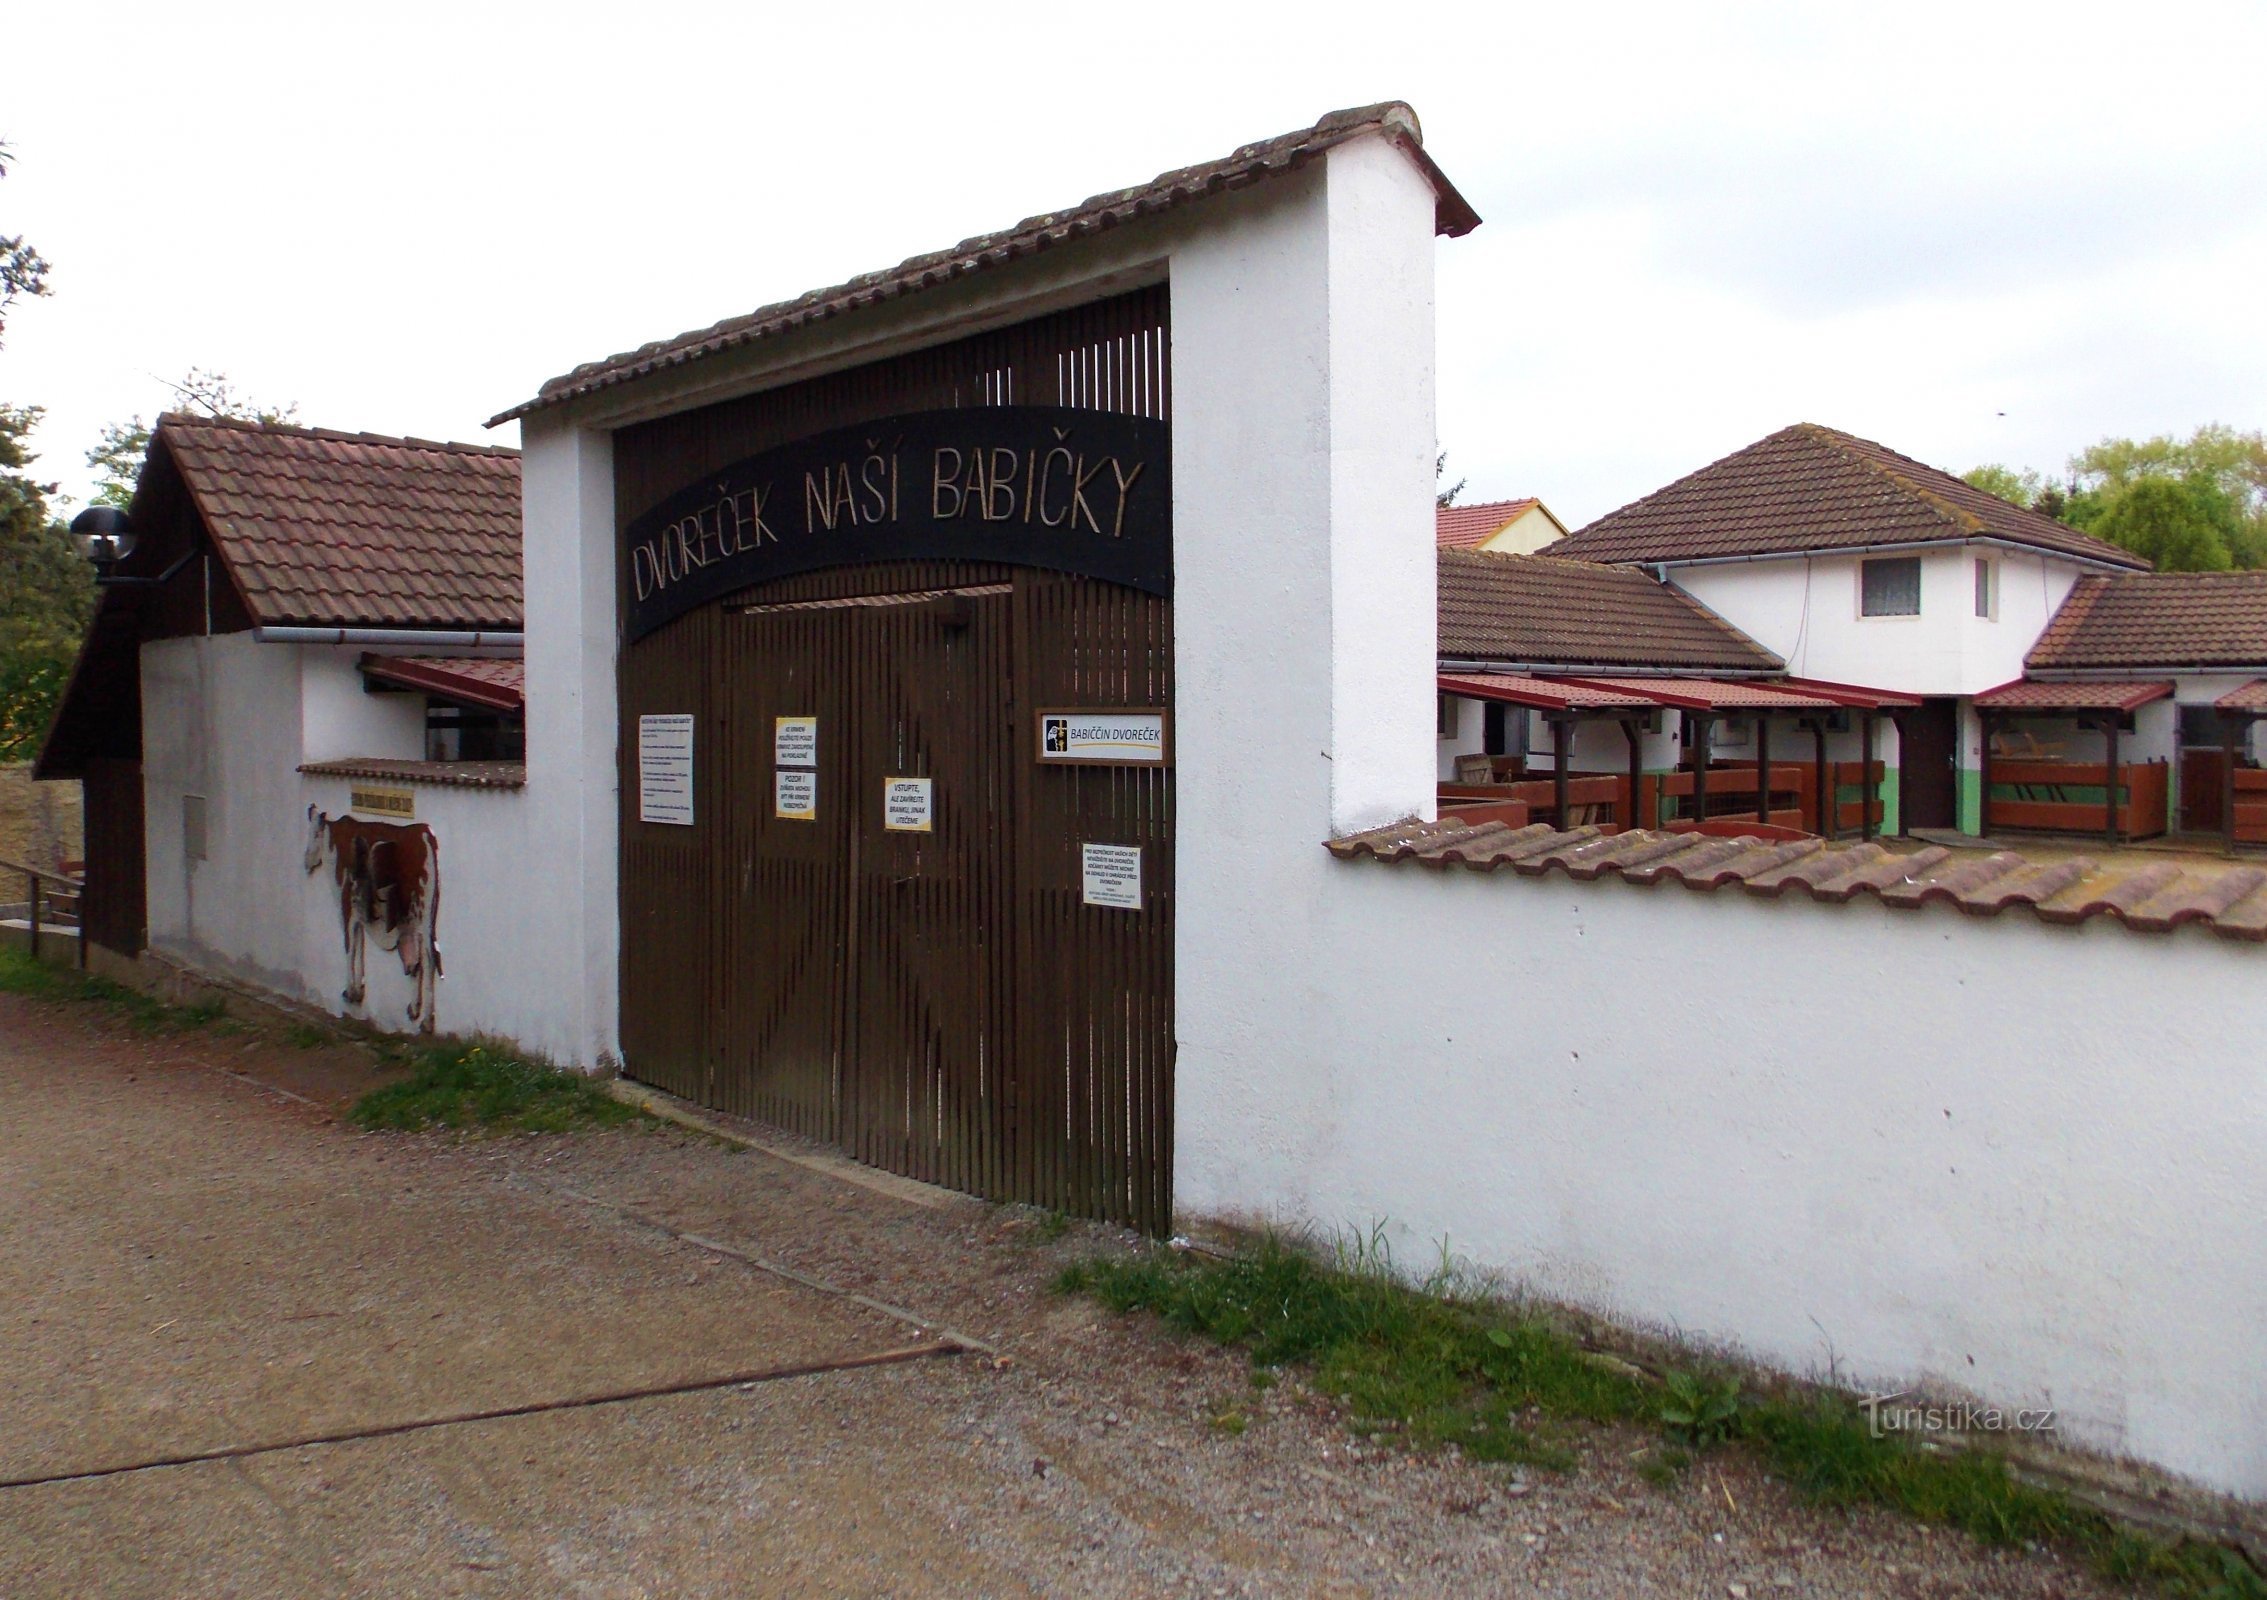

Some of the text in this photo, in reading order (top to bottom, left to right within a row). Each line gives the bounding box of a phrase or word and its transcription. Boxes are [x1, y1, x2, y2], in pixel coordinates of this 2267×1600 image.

[632, 427, 1145, 602] DVOREČEK NAŠÍ BABIČKY
[1071, 726, 1160, 740] BABIČČIN DVOREČEK
[894, 784, 920, 793] VSTUPTE,
